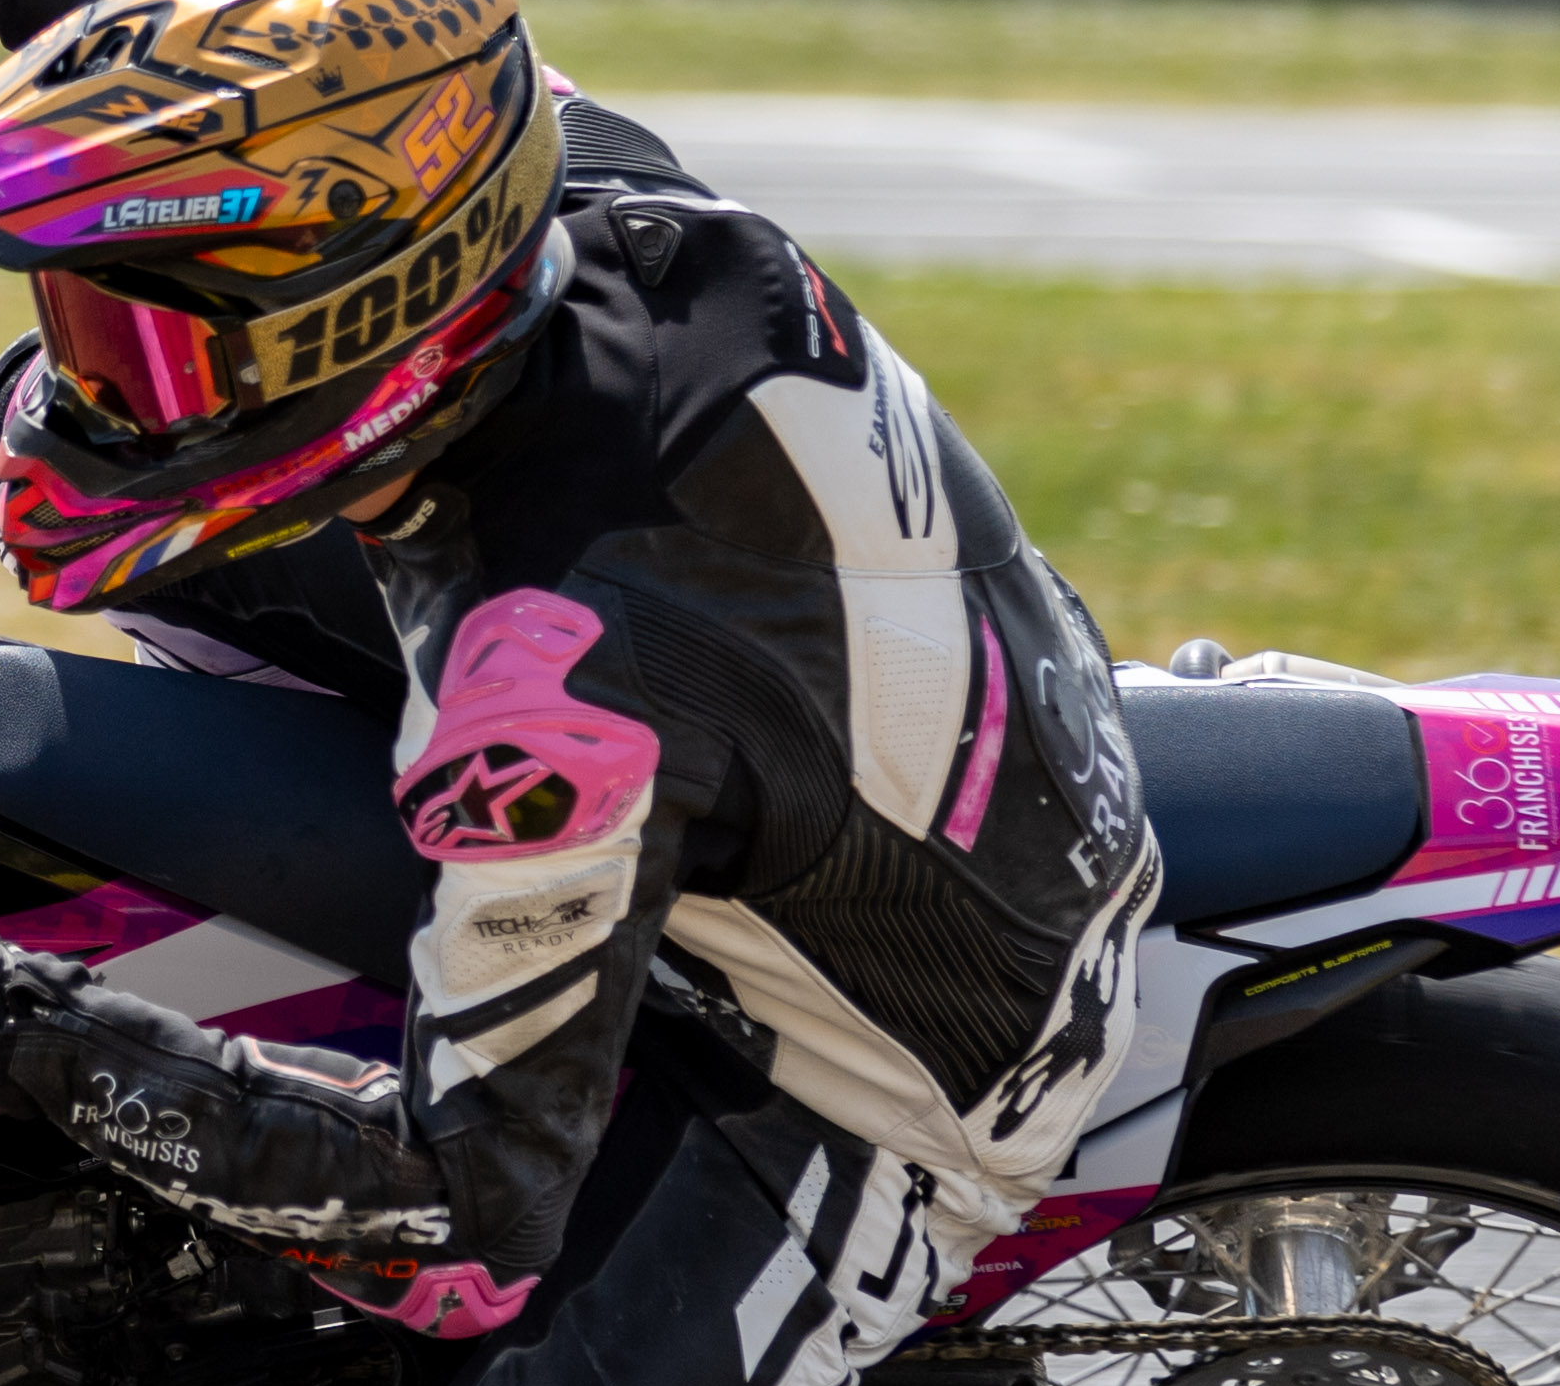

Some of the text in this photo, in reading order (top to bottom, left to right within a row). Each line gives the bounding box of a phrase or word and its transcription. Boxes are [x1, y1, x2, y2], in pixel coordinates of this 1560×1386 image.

[400, 70, 496, 201] 52
[276, 172, 525, 389] 100%
[342, 382, 440, 453] MEDIA
[1506, 714, 1549, 851] FRANCHISES
[472, 916, 532, 939] TECH
[502, 930, 575, 955] READY
